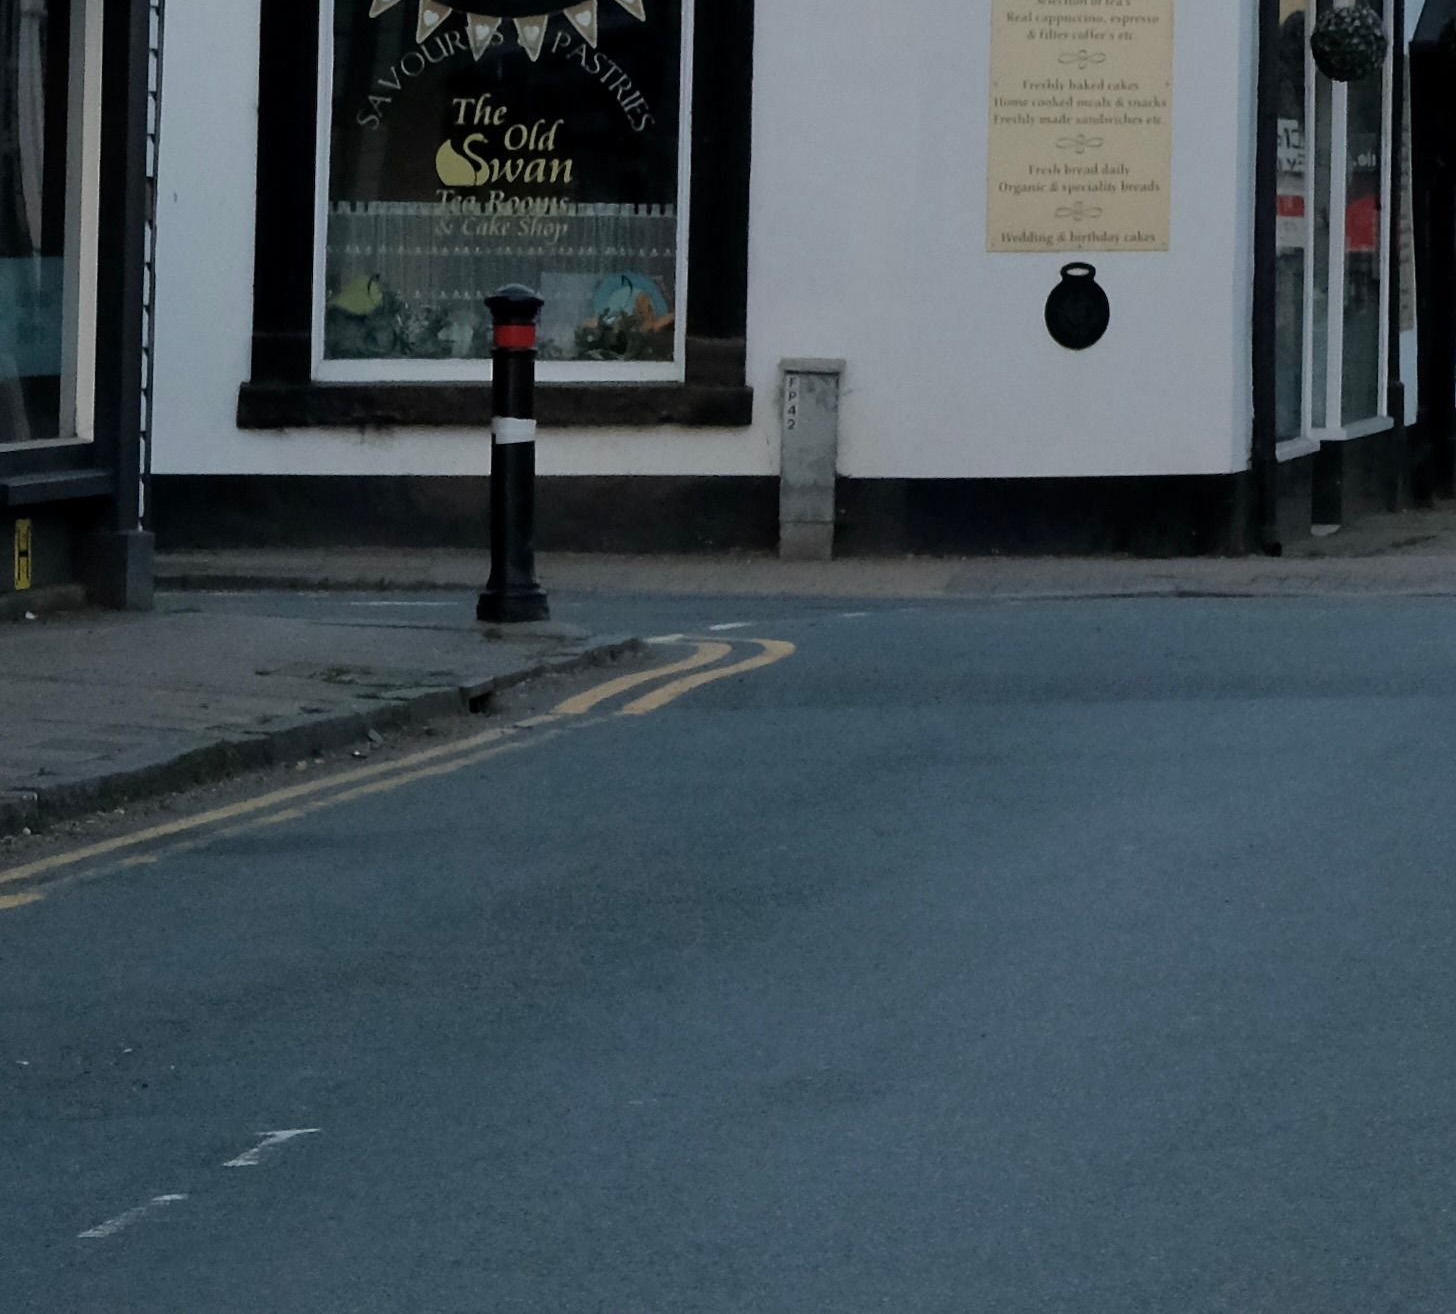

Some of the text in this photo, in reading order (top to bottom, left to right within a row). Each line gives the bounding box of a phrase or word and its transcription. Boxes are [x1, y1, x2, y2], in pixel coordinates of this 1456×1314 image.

[1006, 12, 1033, 23] Real
[1110, 15, 1160, 27] espresso
[1026, 29, 1037, 40] &
[1039, 28, 1069, 40] filter
[551, 31, 656, 133] PASTRIES
[1023, 78, 1139, 92] Freshly baked cakes
[452, 93, 508, 125] The
[994, 95, 1167, 107] Home cooked meals & snacks
[993, 113, 1035, 127] Freshly
[1039, 113, 1073, 124] made
[1075, 113, 1143, 124] sandwiches
[504, 119, 565, 151] Old
[460, 133, 573, 186] Swan
[1029, 163, 1130, 176] Fresh bread daily
[998, 182, 1047, 196] Organic
[1049, 182, 1058, 192] &
[1120, 180, 1160, 192] breads
[436, 189, 570, 215] Tea Rooms
[436, 215, 569, 244] & Cake Shop
[1001, 230, 1156, 246] Wedding & birthday cakes
